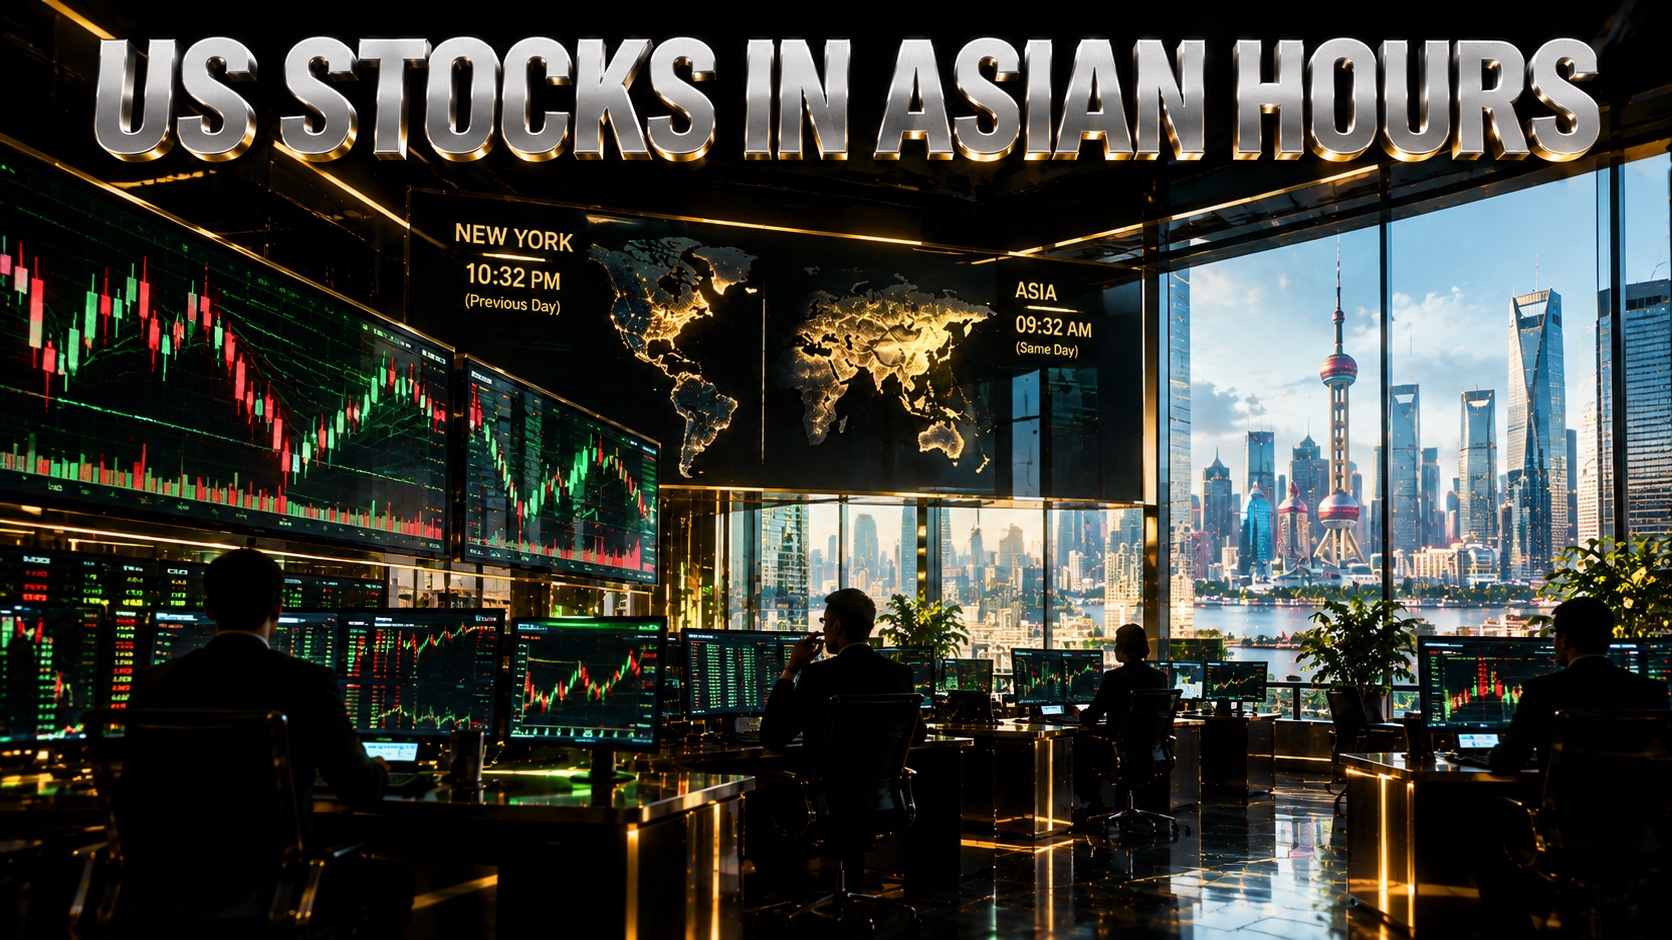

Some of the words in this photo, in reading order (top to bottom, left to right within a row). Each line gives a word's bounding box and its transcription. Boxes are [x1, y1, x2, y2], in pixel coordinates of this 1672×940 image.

[455, 222, 508, 246] NEW
[514, 228, 573, 252] YORK
[466, 262, 525, 288] 10:32
[531, 270, 560, 290] PM
[1015, 281, 1057, 301] ASIA
[465, 292, 527, 311] (Previous
[531, 298, 560, 315] Day)
[1015, 315, 1063, 336] 09:32
[1067, 321, 1092, 338] AM
[1016, 341, 1051, 355] (Same
[1054, 343, 1078, 358] Day)
